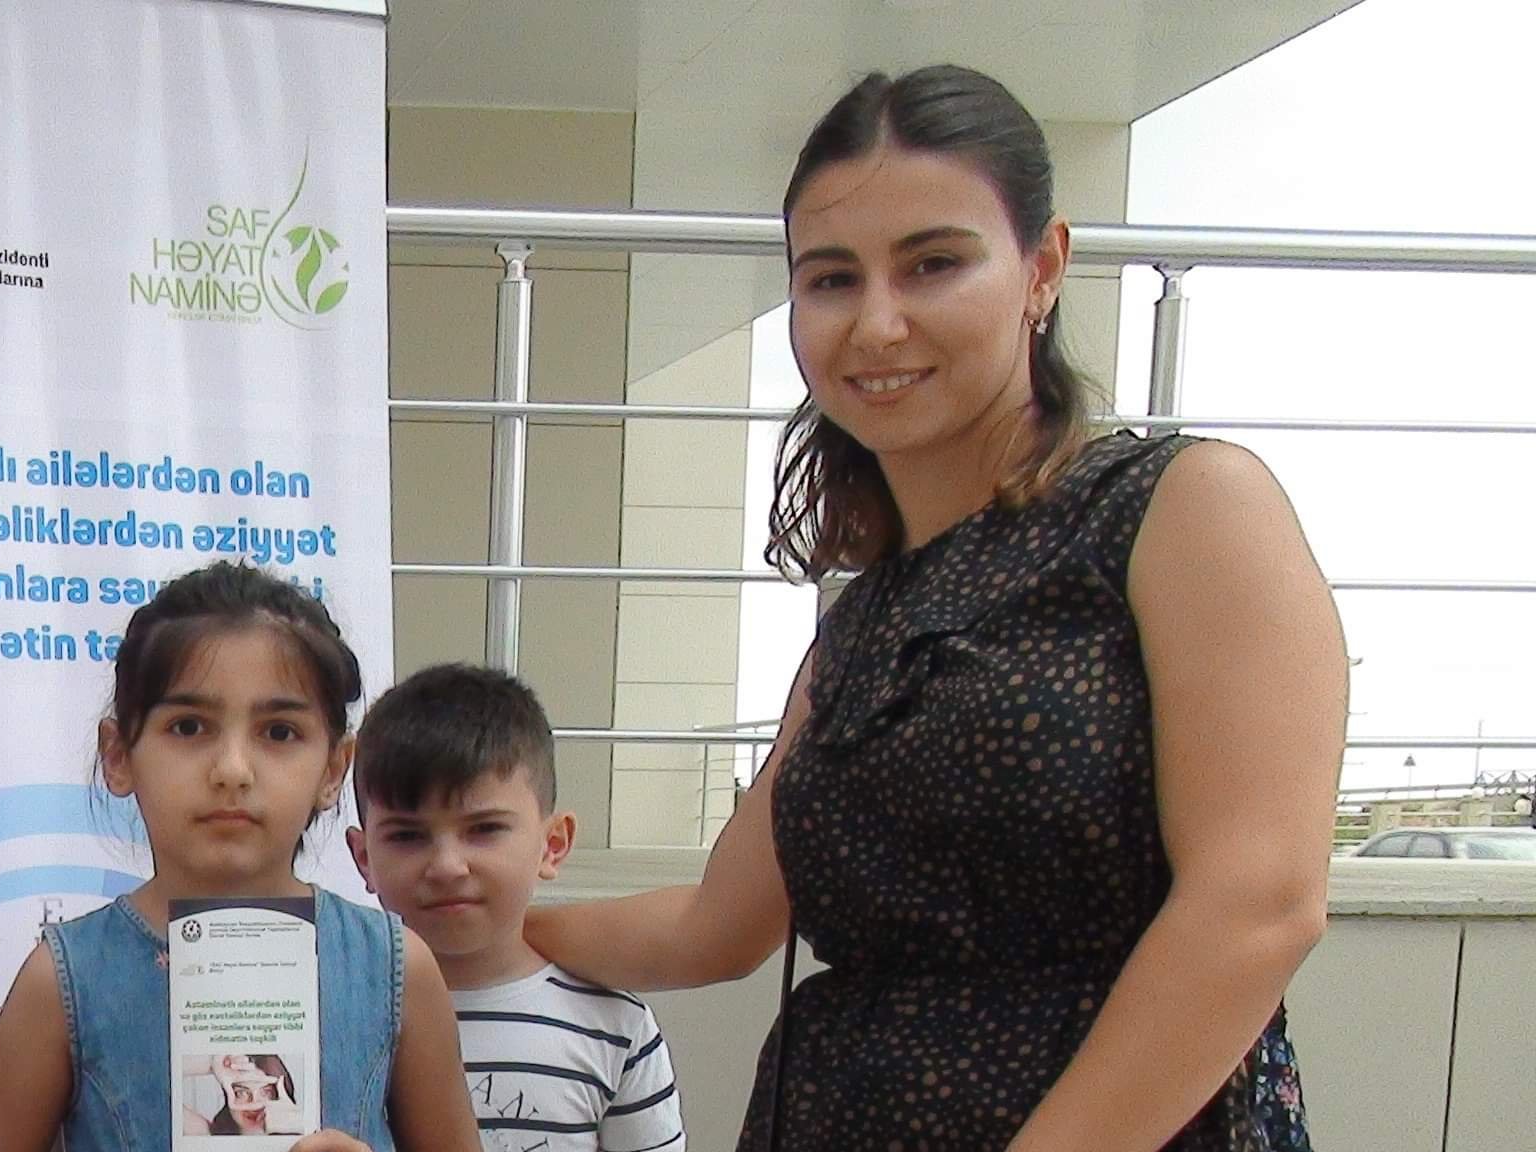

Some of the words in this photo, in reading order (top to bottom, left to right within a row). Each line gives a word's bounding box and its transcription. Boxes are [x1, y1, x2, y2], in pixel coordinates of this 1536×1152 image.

[207, 204, 270, 240] SAF
[153, 238, 262, 276] HƏYAT
[129, 272, 262, 314] NAMİNƏ
[26, 450, 220, 494] ailələrdən
[230, 461, 310, 498] olan
[193, 517, 336, 565] əziyyət
